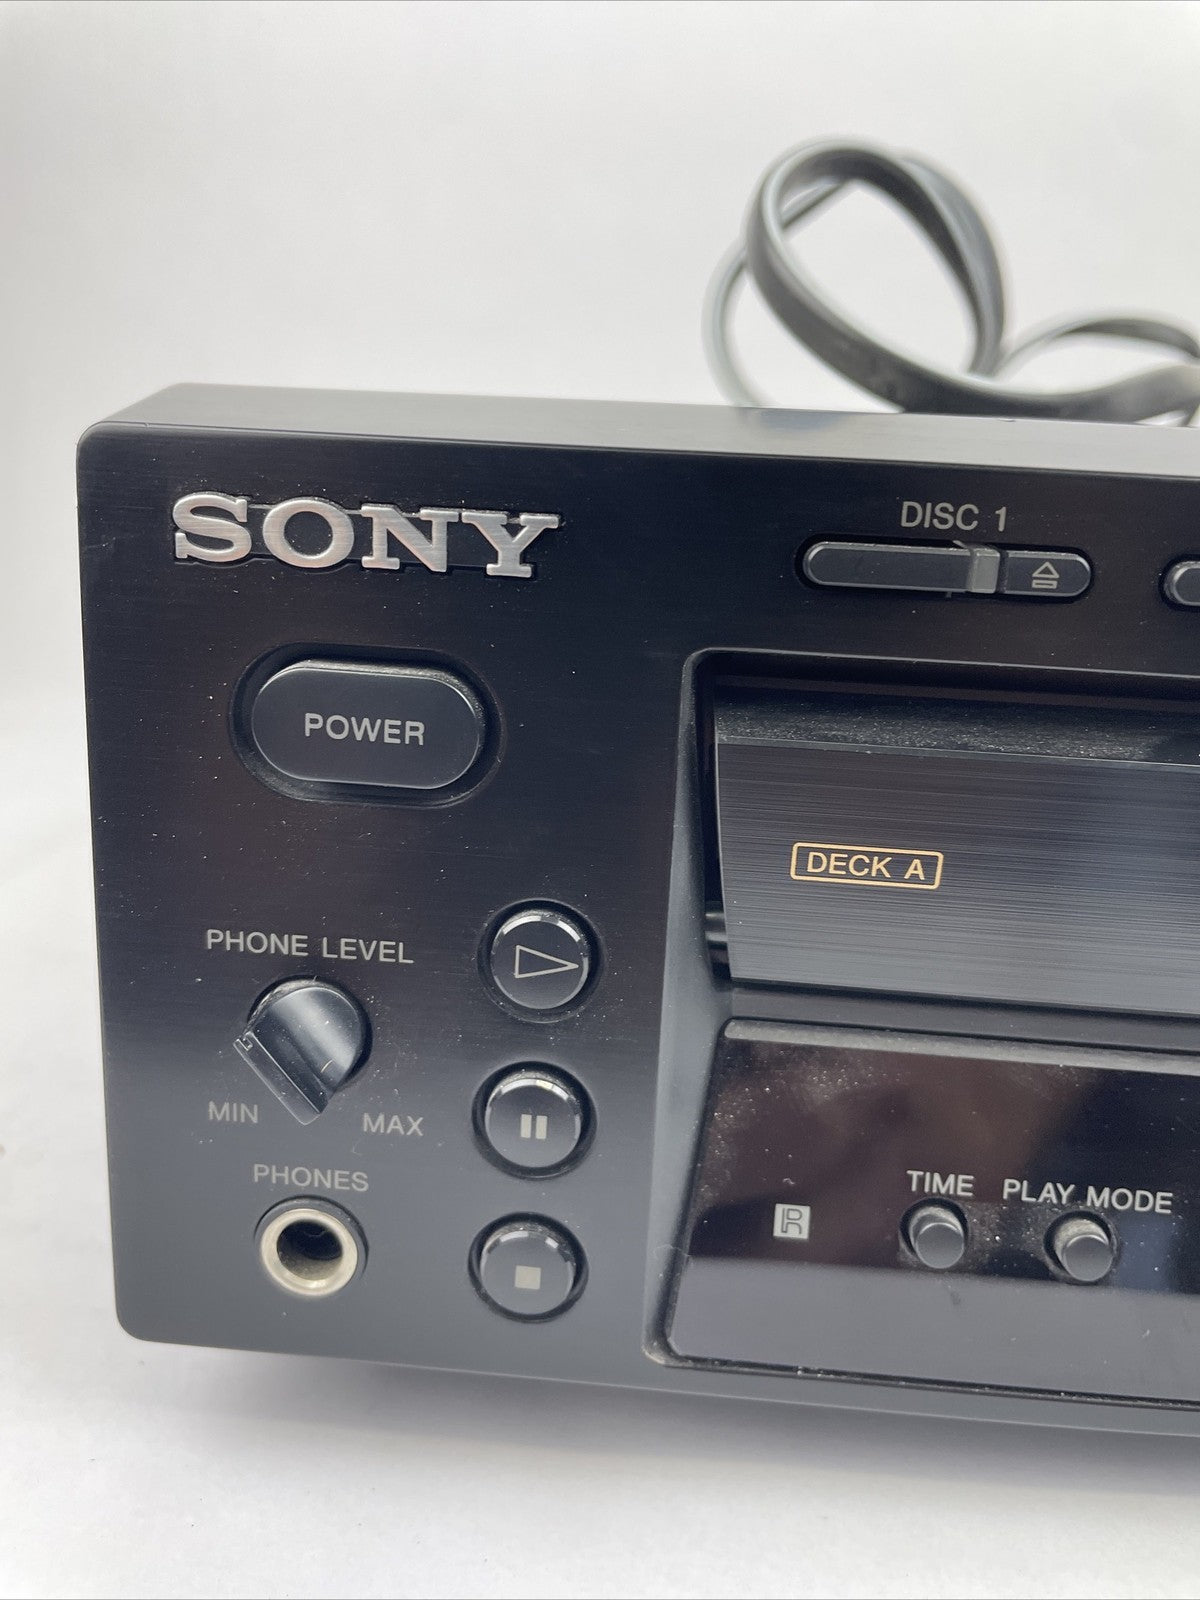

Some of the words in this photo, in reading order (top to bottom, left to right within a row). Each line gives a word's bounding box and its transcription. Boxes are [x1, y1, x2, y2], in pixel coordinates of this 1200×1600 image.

[900, 501, 979, 531] DISC
[994, 506, 1008, 532] 1
[172, 492, 560, 578] SONY
[304, 712, 425, 746] POWER
[807, 852, 892, 879] DECK
[903, 858, 926, 881] A
[206, 929, 309, 957] PHONE
[322, 936, 414, 964] LEVEL
[208, 1101, 259, 1124] MIN
[362, 1113, 424, 1137] MAX
[253, 1163, 369, 1192] PHONES
[907, 1170, 974, 1197] TIME
[1003, 1178, 1075, 1204] PLAY
[1085, 1185, 1173, 1214] MODE
